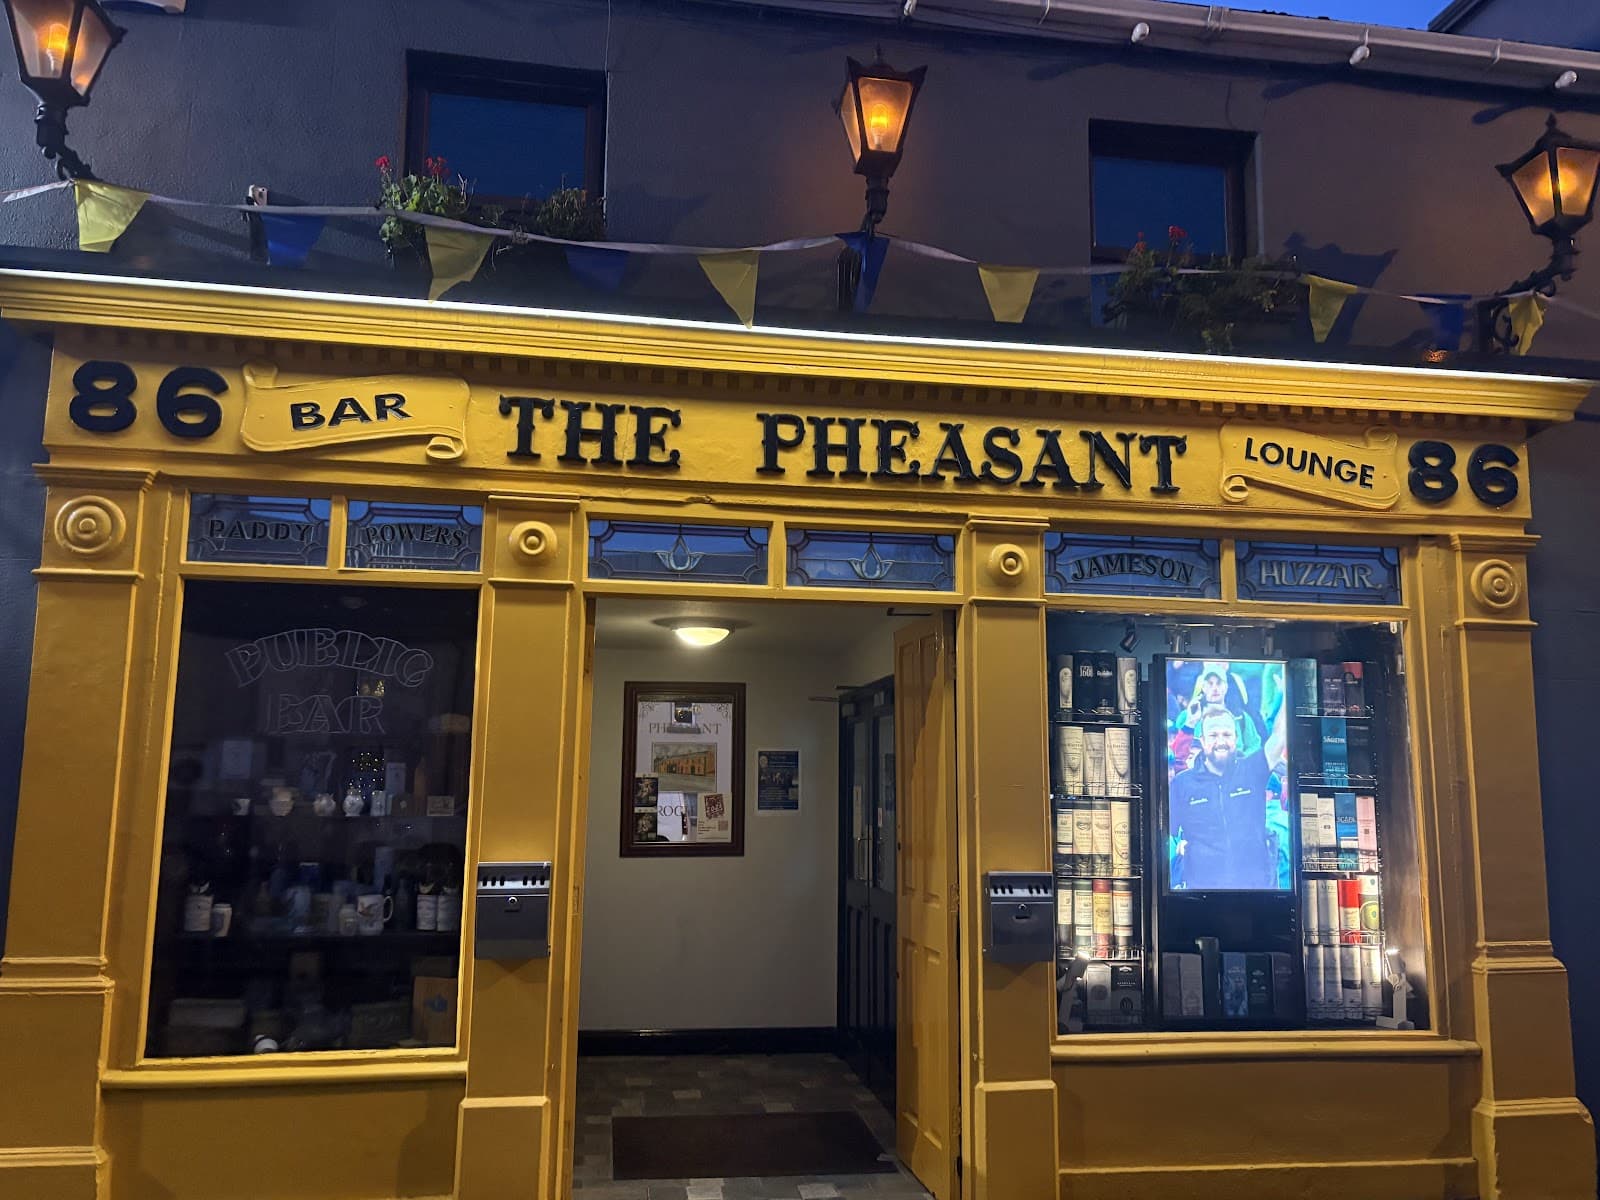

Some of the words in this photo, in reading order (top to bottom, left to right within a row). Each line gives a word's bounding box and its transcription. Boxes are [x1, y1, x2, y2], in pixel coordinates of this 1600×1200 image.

[68, 360, 230, 438] 86
[290, 393, 411, 431] BAR
[499, 394, 682, 469] THE
[756, 411, 1187, 493] PHEASANT
[1246, 438, 1375, 489] LOUNGE
[1407, 440, 1521, 507] 86
[207, 518, 315, 542] PADDY
[365, 523, 467, 547] POWERS
[1070, 553, 1194, 584] JAMESON
[1260, 559, 1382, 590] HUZZAR
[225, 628, 434, 688] PUBLIC
[268, 694, 386, 735] BAR
